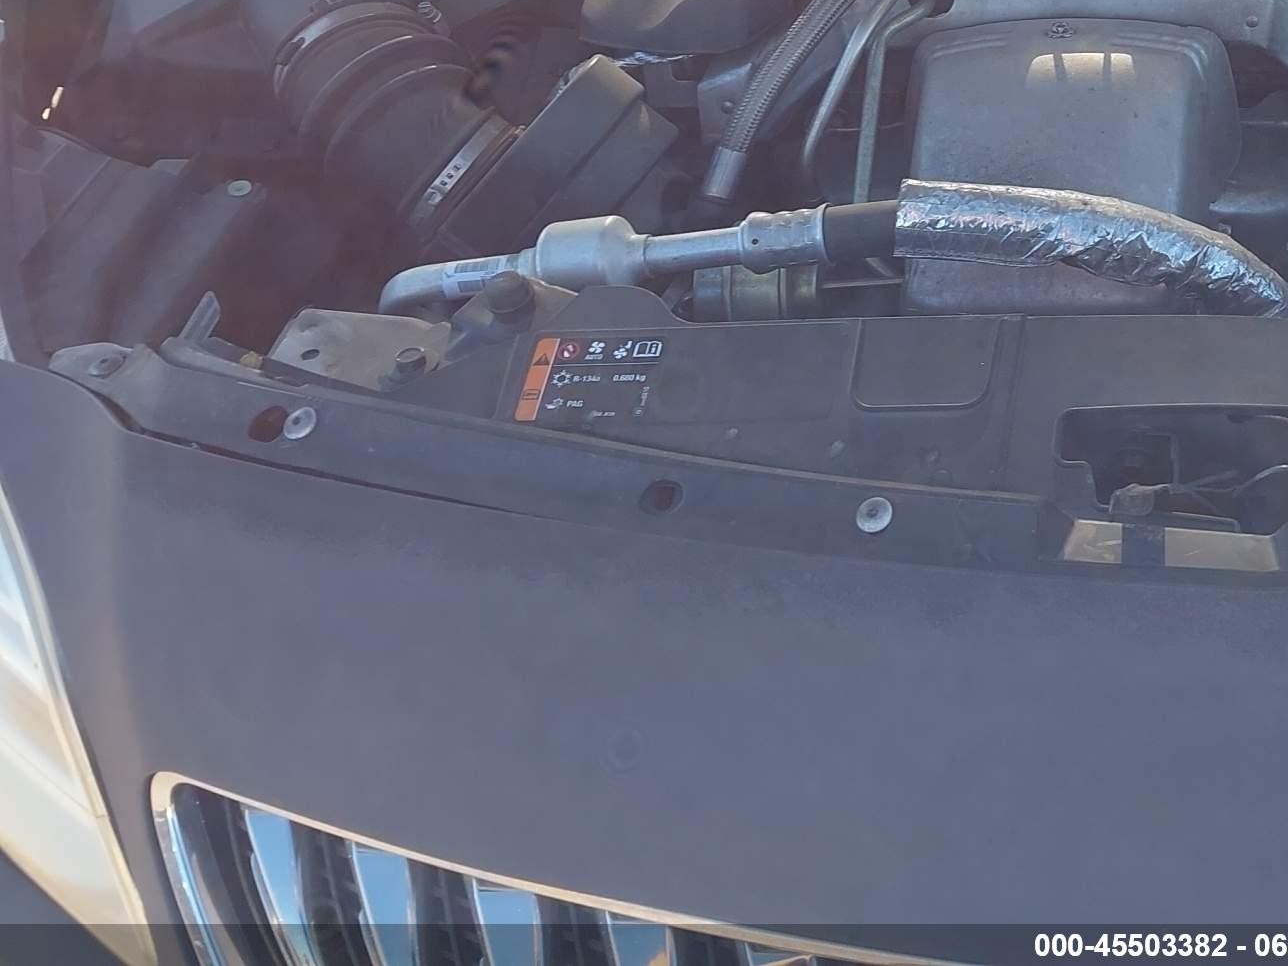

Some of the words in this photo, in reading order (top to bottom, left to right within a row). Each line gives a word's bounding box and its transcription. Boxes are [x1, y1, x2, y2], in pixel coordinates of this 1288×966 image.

[584, 353, 604, 361] AUTO
[572, 375, 601, 383] R-134a
[635, 374, 647, 383] kg
[566, 400, 584, 408] PAG
